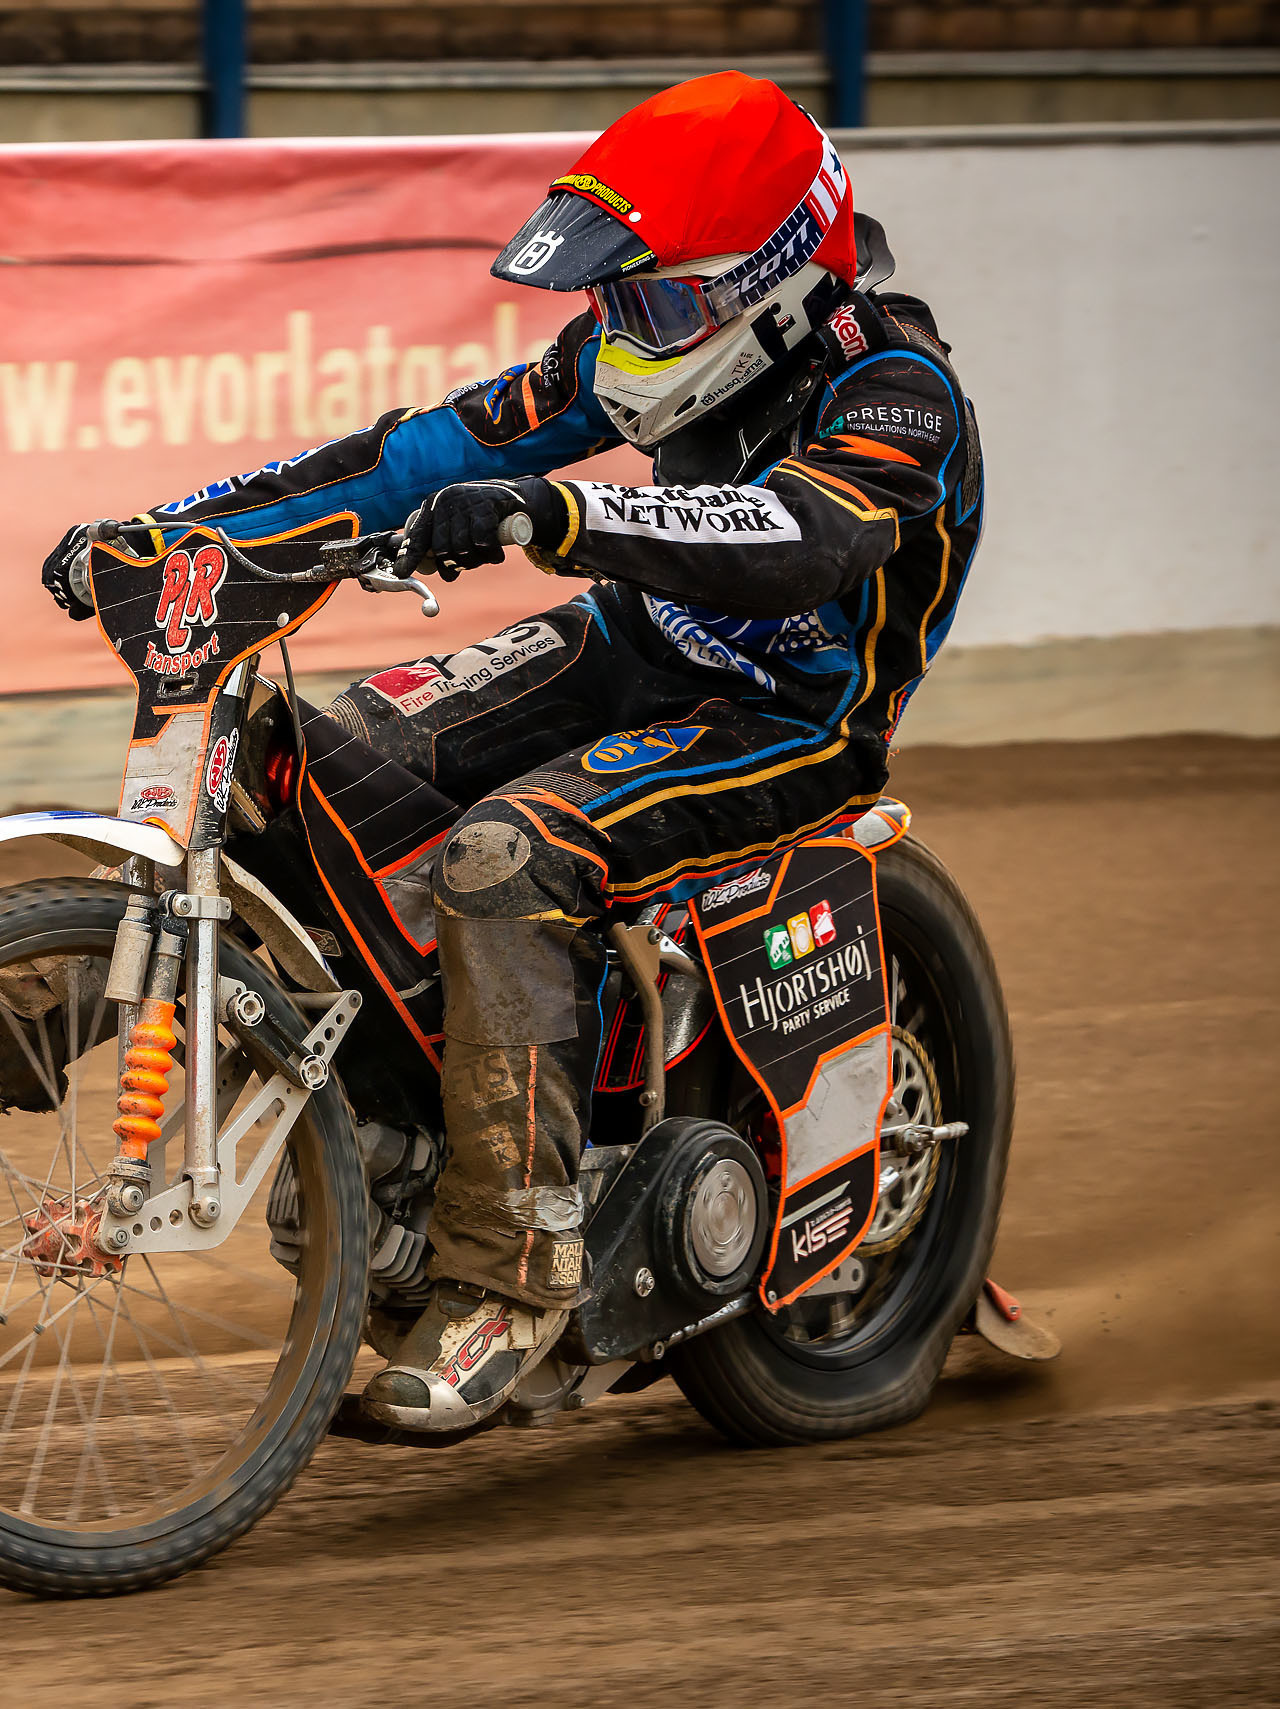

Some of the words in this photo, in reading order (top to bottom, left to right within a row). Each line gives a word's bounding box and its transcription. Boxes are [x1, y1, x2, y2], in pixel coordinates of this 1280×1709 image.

[591, 182, 632, 213] PRODUCTS
[721, 217, 809, 307] SCOTT
[846, 406, 943, 433] PRESTIGE
[847, 423, 907, 435] INSTALLATIONS
[907, 428, 929, 440] NORTH
[599, 496, 784, 533] NETWORK
[144, 631, 220, 678] Transport
[400, 691, 434, 712] Fire
[490, 636, 556, 670] Services
[782, 1008, 812, 1036] PARTY
[813, 987, 851, 1020] SERVICE
[553, 1243, 584, 1259] MALI
